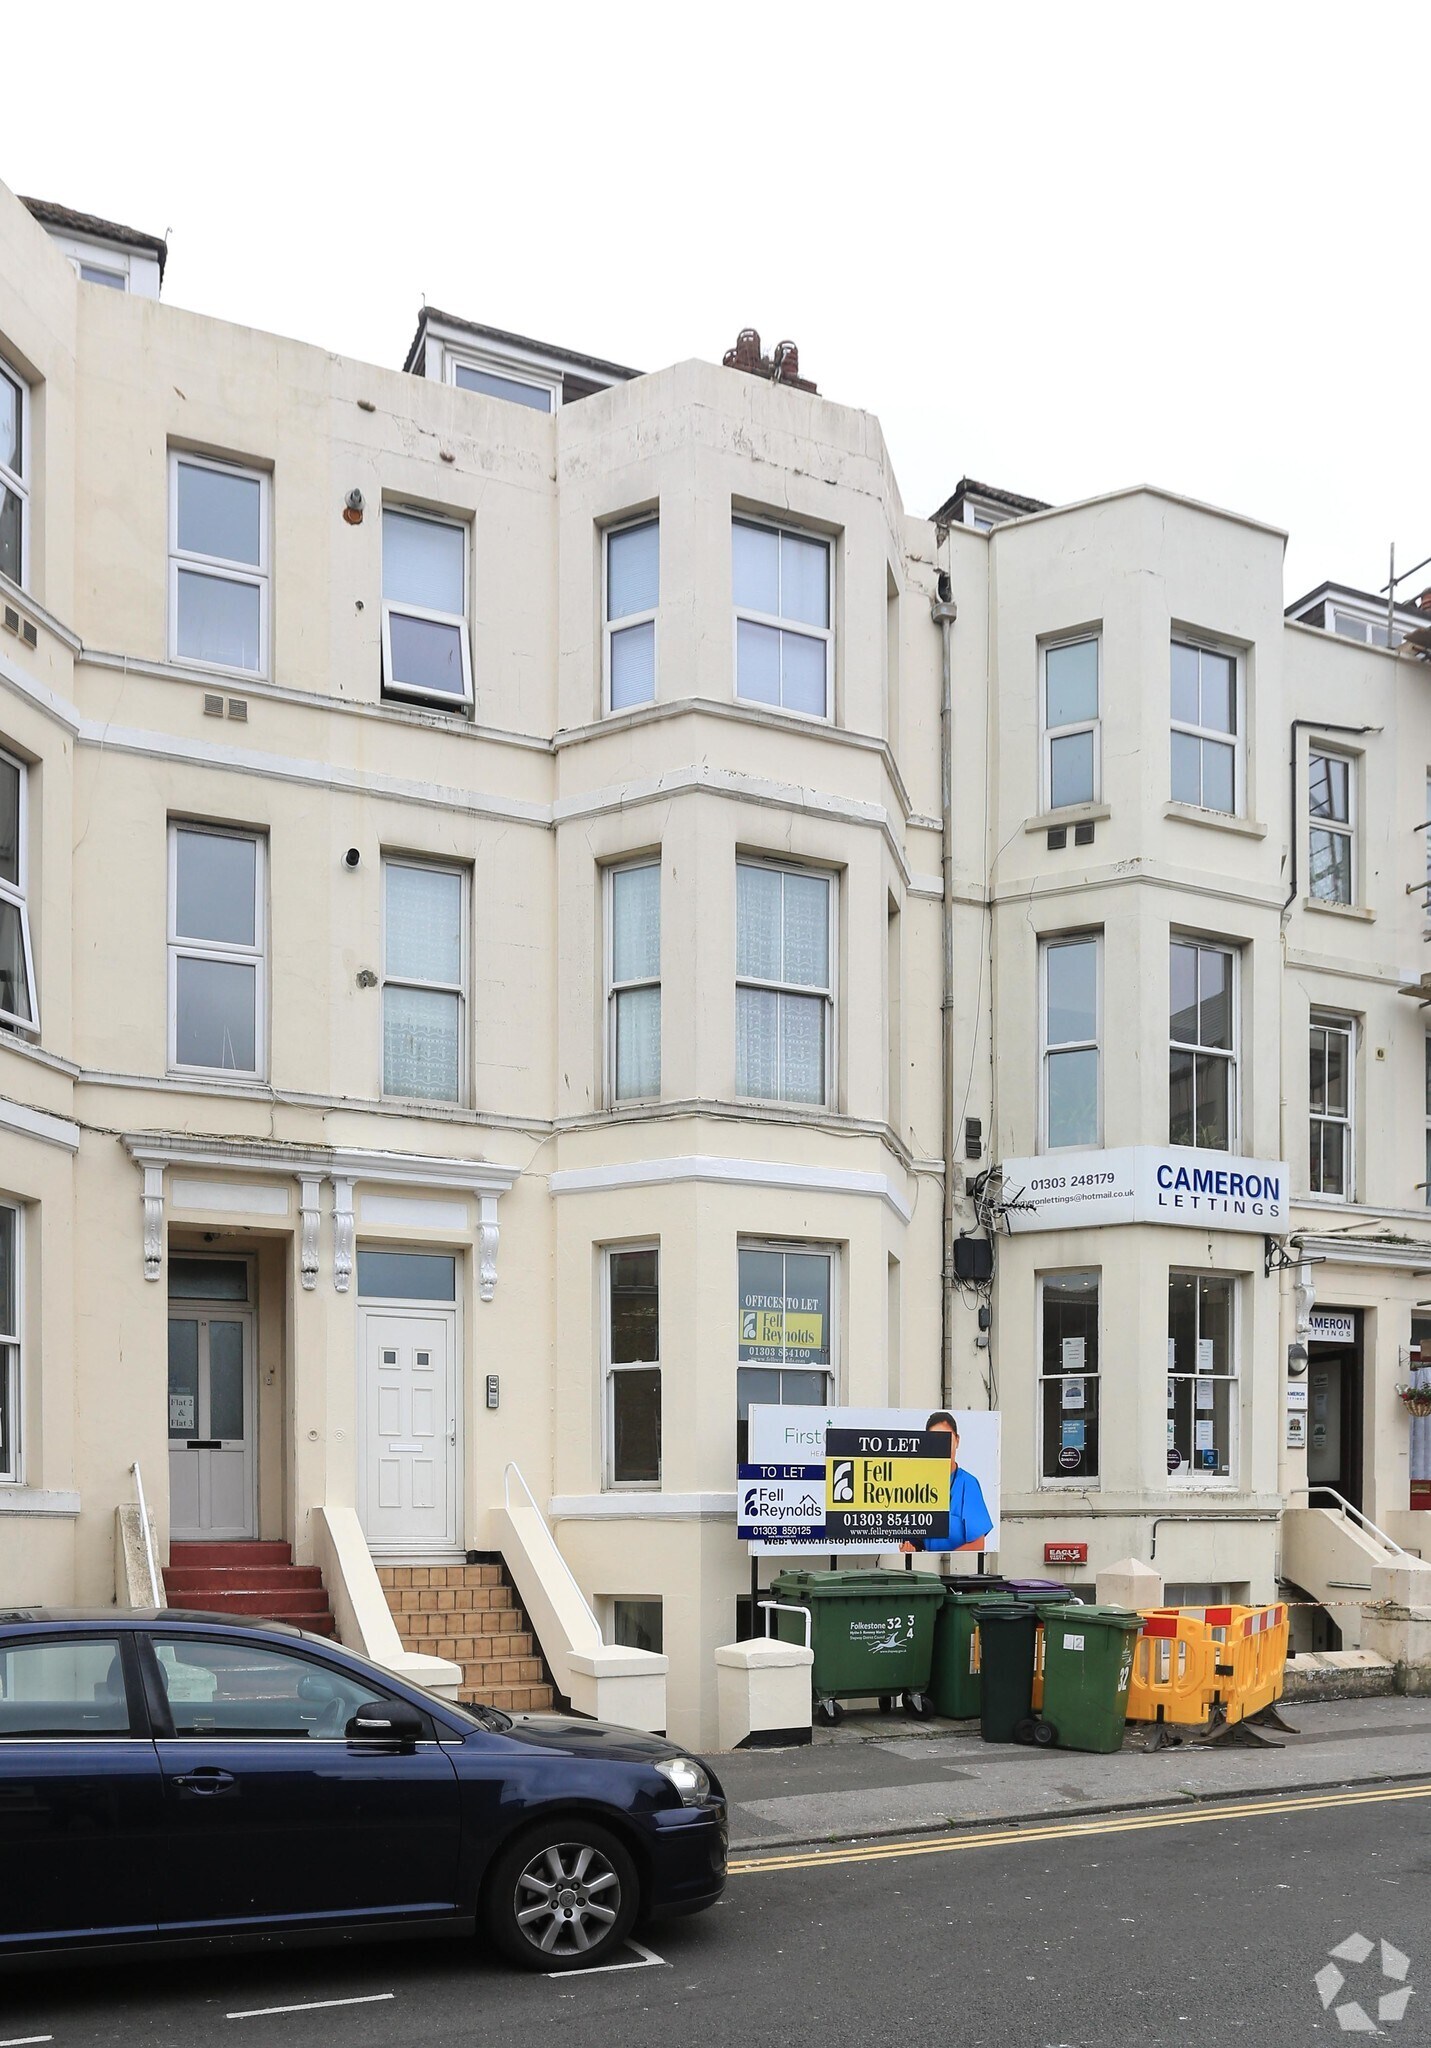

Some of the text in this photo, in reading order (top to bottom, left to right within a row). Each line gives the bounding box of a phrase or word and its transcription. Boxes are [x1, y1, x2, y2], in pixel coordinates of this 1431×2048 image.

[1031, 1172, 1115, 1190] 01303 248179
[1157, 1164, 1279, 1200] CAMERON
[1016, 1189, 1135, 1207] meronlettings@hotmail.co.uk
[1158, 1193, 1280, 1217] LETTINGS
[745, 1295, 819, 1311] OFFICES TO LET
[763, 1312, 783, 1328] Fell
[1308, 1317, 1351, 1330] AMERON
[762, 1326, 815, 1345] Reynolds
[1308, 1329, 1351, 1337] TTINGS
[749, 1347, 810, 1358] 01303 854100
[188, 1399, 193, 1407] 2
[178, 1409, 185, 1417] &
[171, 1419, 193, 1427] Flat 3
[785, 1427, 826, 1445] First
[859, 1437, 920, 1452] TO LET
[760, 1466, 806, 1478] TO LET
[864, 1460, 892, 1482] Fell
[759, 1488, 784, 1502] Fell
[864, 1483, 938, 1508] Reynolds
[759, 1504, 822, 1520] Reynolds
[843, 1513, 933, 1526] 01303 854100
[753, 1527, 811, 1536] 01303 850125
[850, 1527, 927, 1537] www.fellreynolds.com
[850, 1615, 915, 1630] Folkestone 32 3
[906, 1628, 914, 1638] 4
